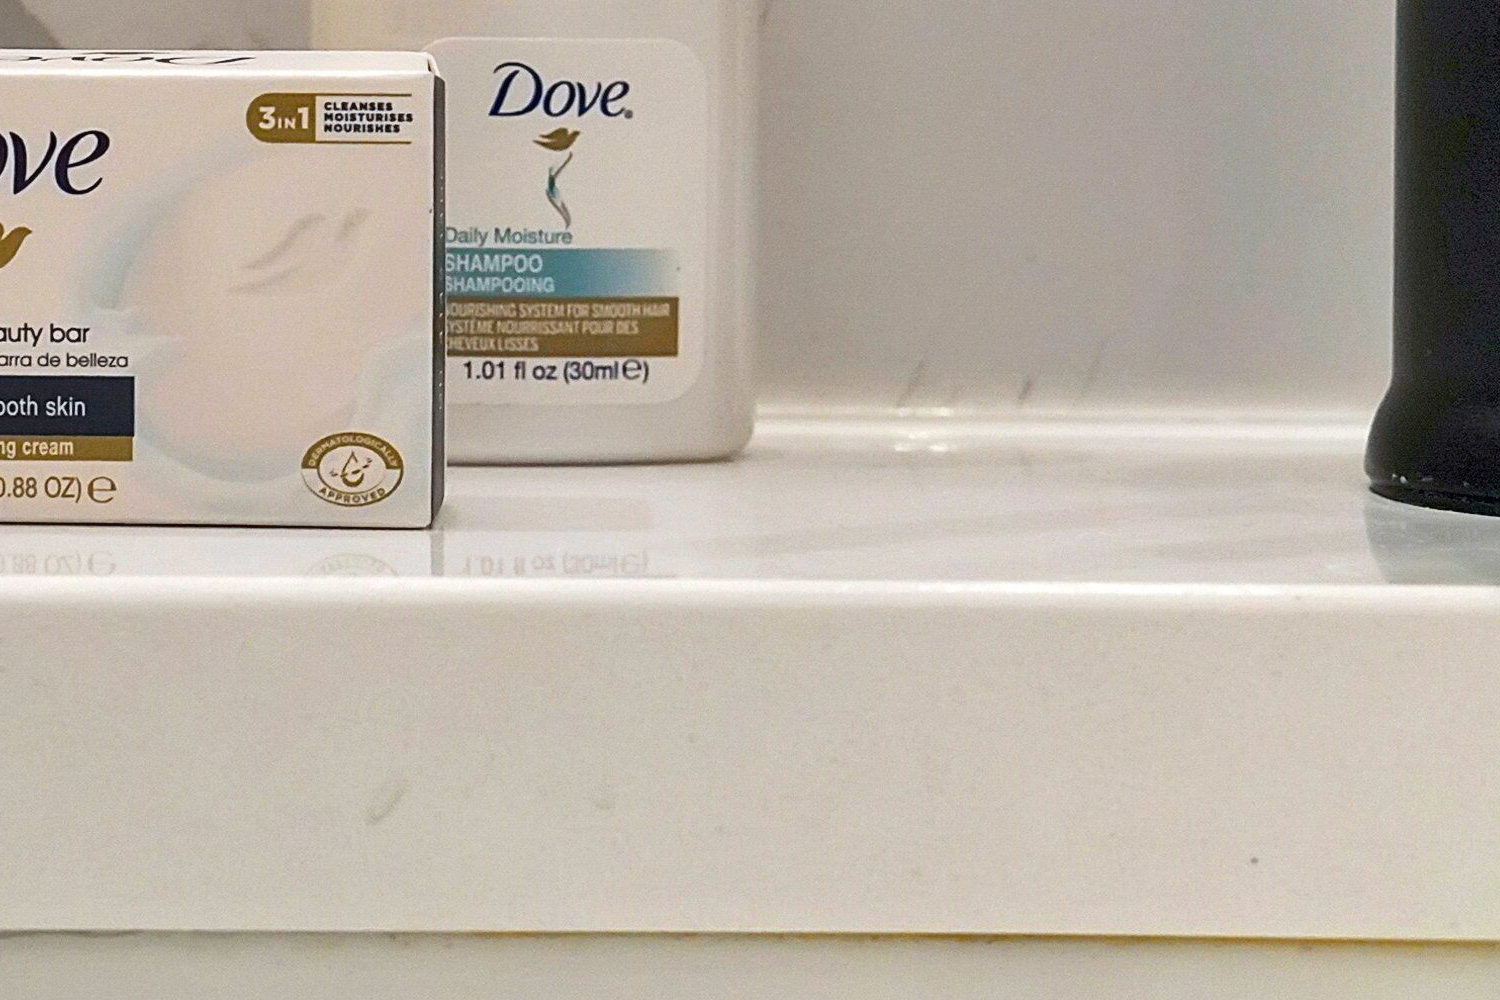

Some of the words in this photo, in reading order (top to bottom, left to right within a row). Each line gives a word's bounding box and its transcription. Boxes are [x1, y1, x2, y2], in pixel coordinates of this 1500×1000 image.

[488, 62, 630, 118] Dove
[324, 101, 393, 111] CLEANSES
[324, 113, 413, 122] MOISTURISES
[324, 123, 400, 133] NOURISHES
[446, 227, 488, 246] Daily
[494, 227, 573, 244] Moisture
[445, 253, 543, 273] SHAMPOO
[519, 303, 565, 318] SYSTEM
[566, 304, 589, 318] FOR
[592, 304, 641, 318] SMOOTH
[642, 304, 670, 317] HAIR
[50, 323, 90, 343] bar
[582, 321, 614, 334] POUR
[616, 321, 639, 334] DES
[499, 337, 539, 351] LISSES
[37, 352, 60, 367] de
[66, 352, 128, 367] belleza
[463, 361, 505, 380] 1.01
[514, 360, 526, 380] fl
[532, 366, 557, 380] oz
[46, 396, 86, 417] skin
[22, 441, 74, 455] cream
[44, 477, 82, 503] OZ)
[319, 487, 386, 503] APPROVED
